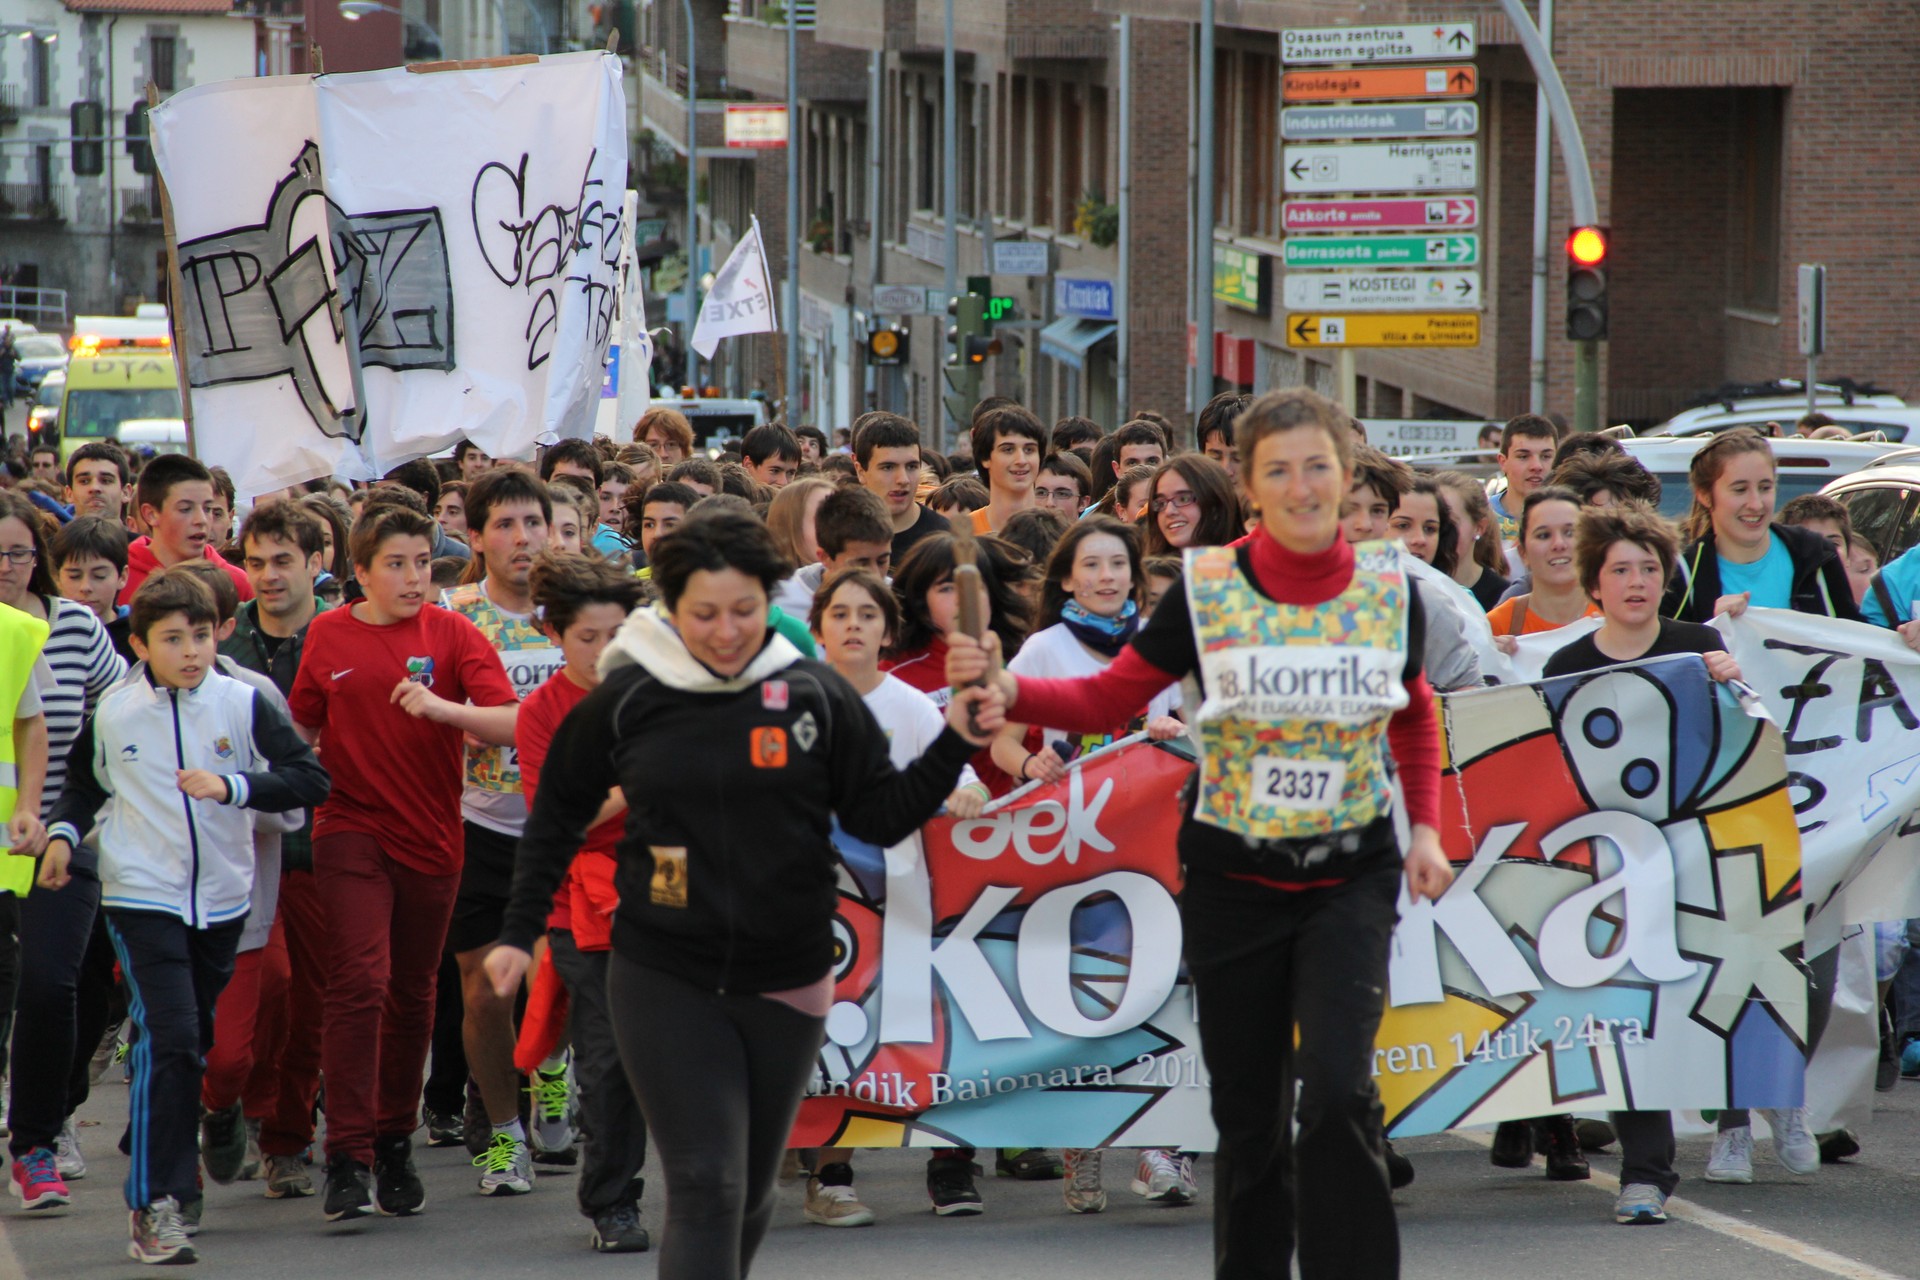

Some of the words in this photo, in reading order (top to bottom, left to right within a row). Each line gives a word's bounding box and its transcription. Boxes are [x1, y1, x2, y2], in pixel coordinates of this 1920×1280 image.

[1285, 32, 1342, 44] Osasun
[1347, 30, 1404, 42] zentrua
[1285, 46, 1352, 59] Zaharren
[1358, 44, 1413, 59] egoitza
[1285, 78, 1361, 92] Kiroldegia
[1389, 144, 1472, 159] Herrigunea
[1288, 208, 1347, 222] Azkorte
[1287, 245, 1372, 260] Berrasoeta
[1349, 277, 1416, 291] KOSTEGI
[92, 360, 164, 376] DTA
[1217, 656, 1394, 699] 18.korrika
[1260, 699, 1335, 716] EUSKARA
[1266, 767, 1331, 800] 2337
[950, 764, 1116, 866] aek
[802, 1070, 918, 1108] indik
[928, 1060, 1116, 1106] Baionara
[1136, 1052, 1212, 1088] 201
[1450, 1021, 1546, 1068] 14tik
[1554, 1013, 1646, 1051] 24ra
